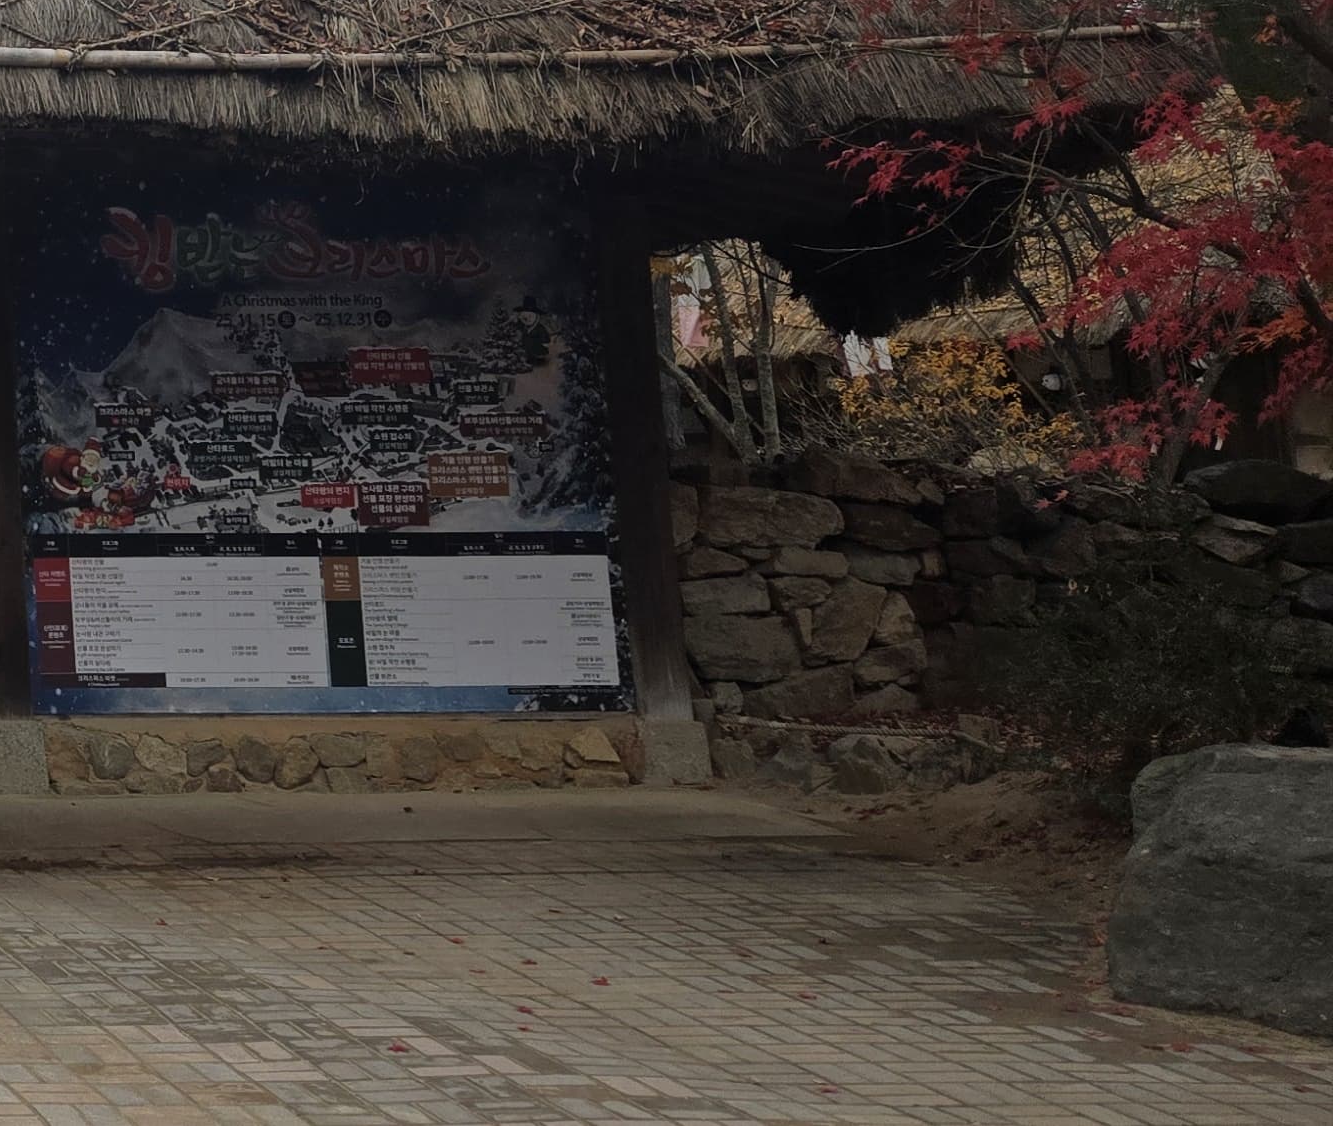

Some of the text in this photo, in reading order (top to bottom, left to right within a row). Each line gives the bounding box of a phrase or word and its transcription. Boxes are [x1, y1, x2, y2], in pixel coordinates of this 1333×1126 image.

[265, 206, 491, 282] 크리스마스
[222, 294, 383, 310] A Christmas with the King
